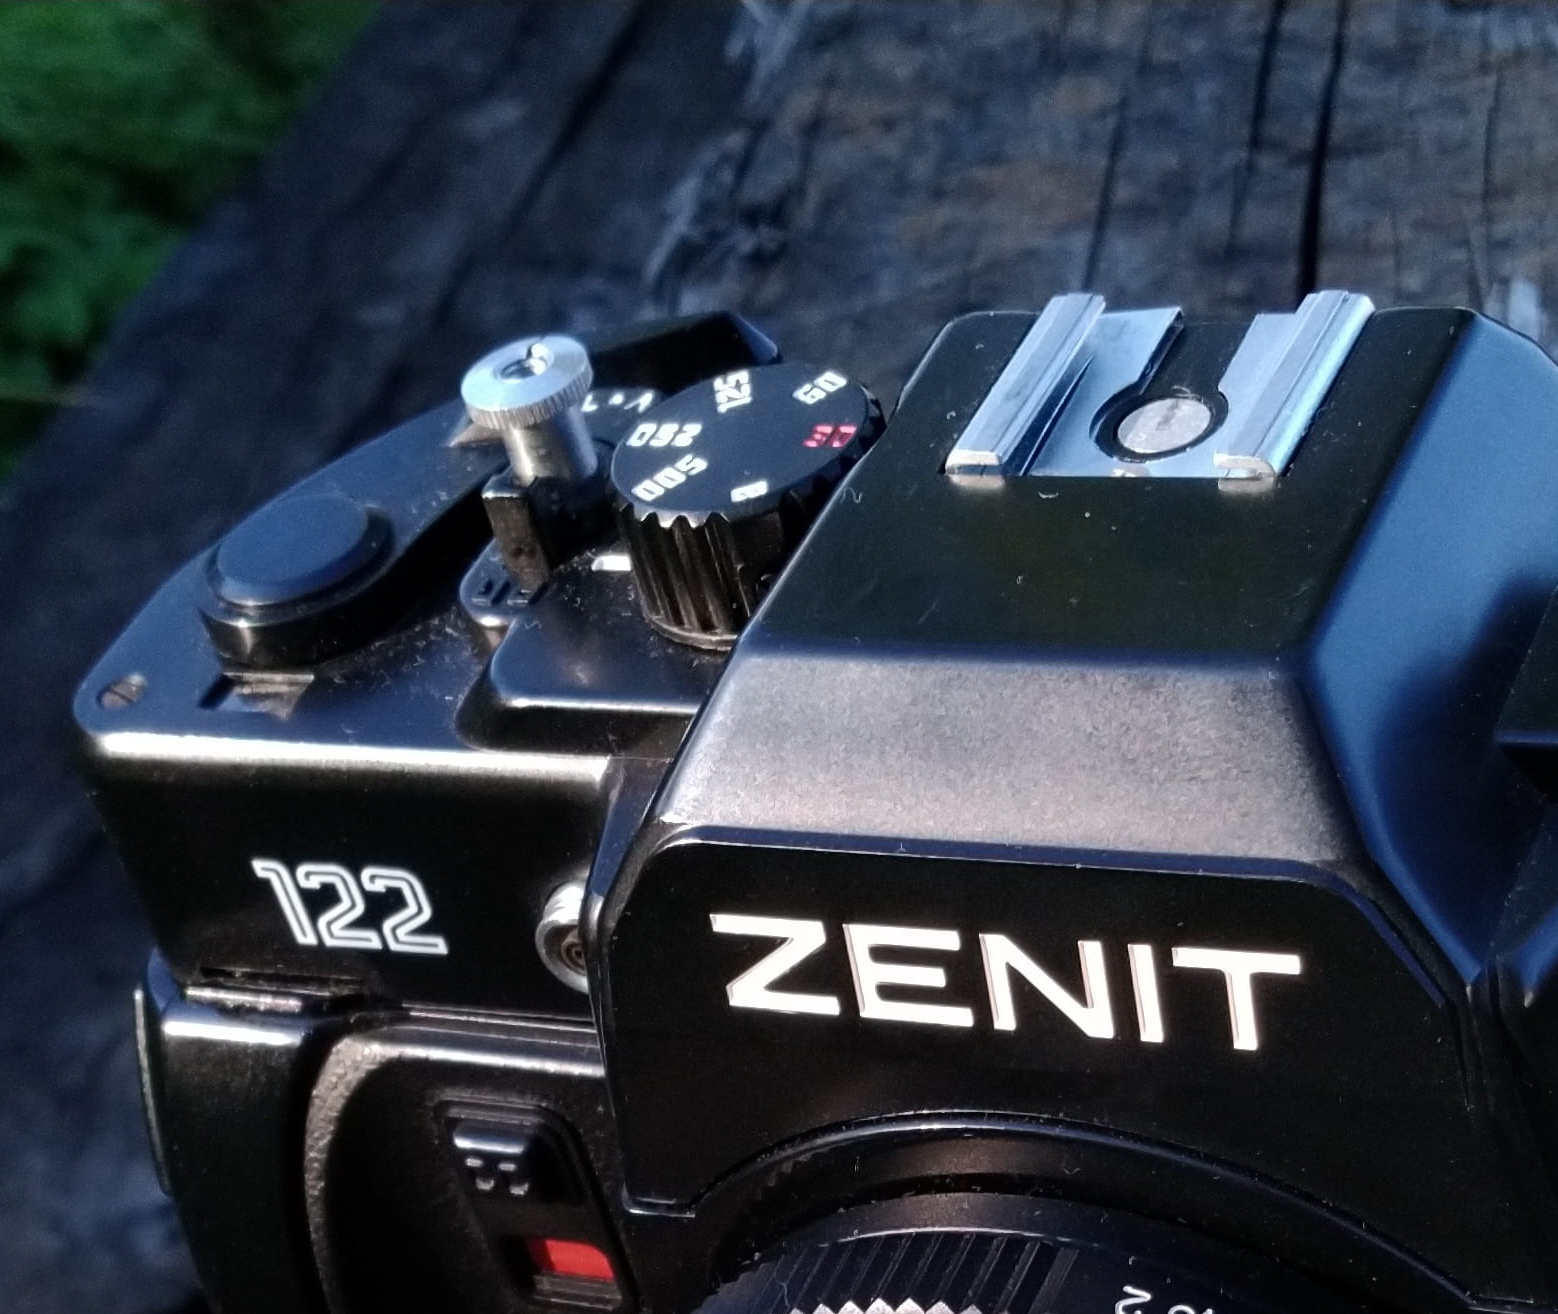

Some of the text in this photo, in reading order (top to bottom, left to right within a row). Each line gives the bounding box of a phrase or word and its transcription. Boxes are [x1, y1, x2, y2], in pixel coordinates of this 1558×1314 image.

[712, 369, 753, 414] 125
[791, 369, 849, 405] 60
[625, 421, 704, 449] 250
[802, 423, 858, 449] 30
[630, 451, 710, 503] 500
[250, 857, 450, 956] 122
[708, 912, 1304, 1053] ZENIT
